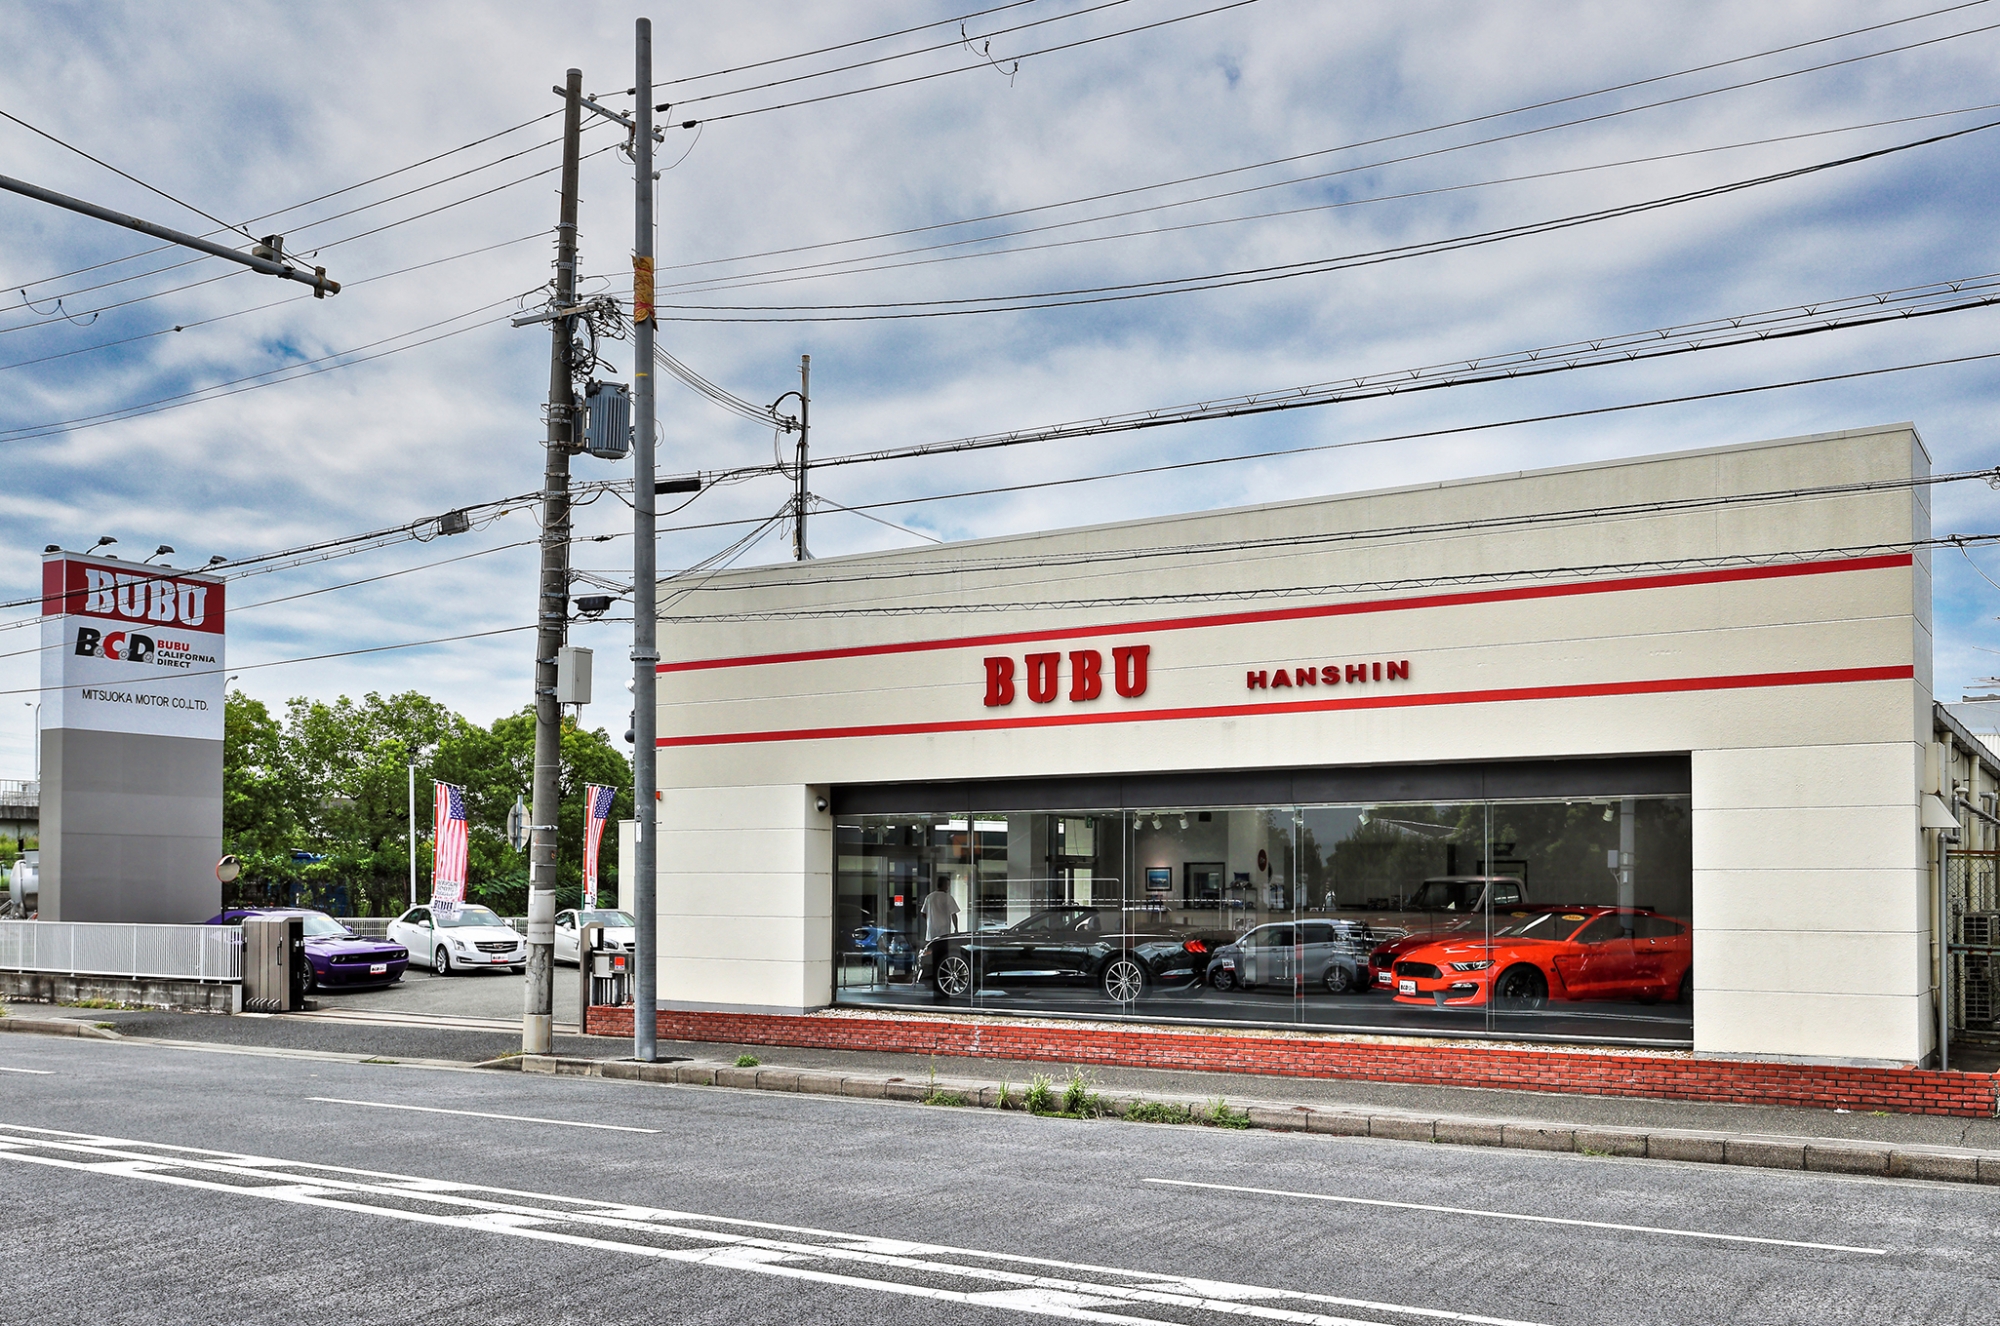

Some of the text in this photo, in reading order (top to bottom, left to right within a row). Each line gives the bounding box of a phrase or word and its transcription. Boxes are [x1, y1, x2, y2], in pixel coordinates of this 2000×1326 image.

[85, 568, 207, 626] BUBU
[75, 627, 155, 664] BCD
[157, 639, 190, 652] BUBU
[157, 650, 216, 663] CALIFORNIA
[157, 659, 191, 669] DIRECT
[984, 645, 1150, 707] BUBU
[1247, 660, 1409, 689] HANSHIN
[82, 688, 133, 704] MITSUOKA
[135, 694, 169, 707] MOTOR
